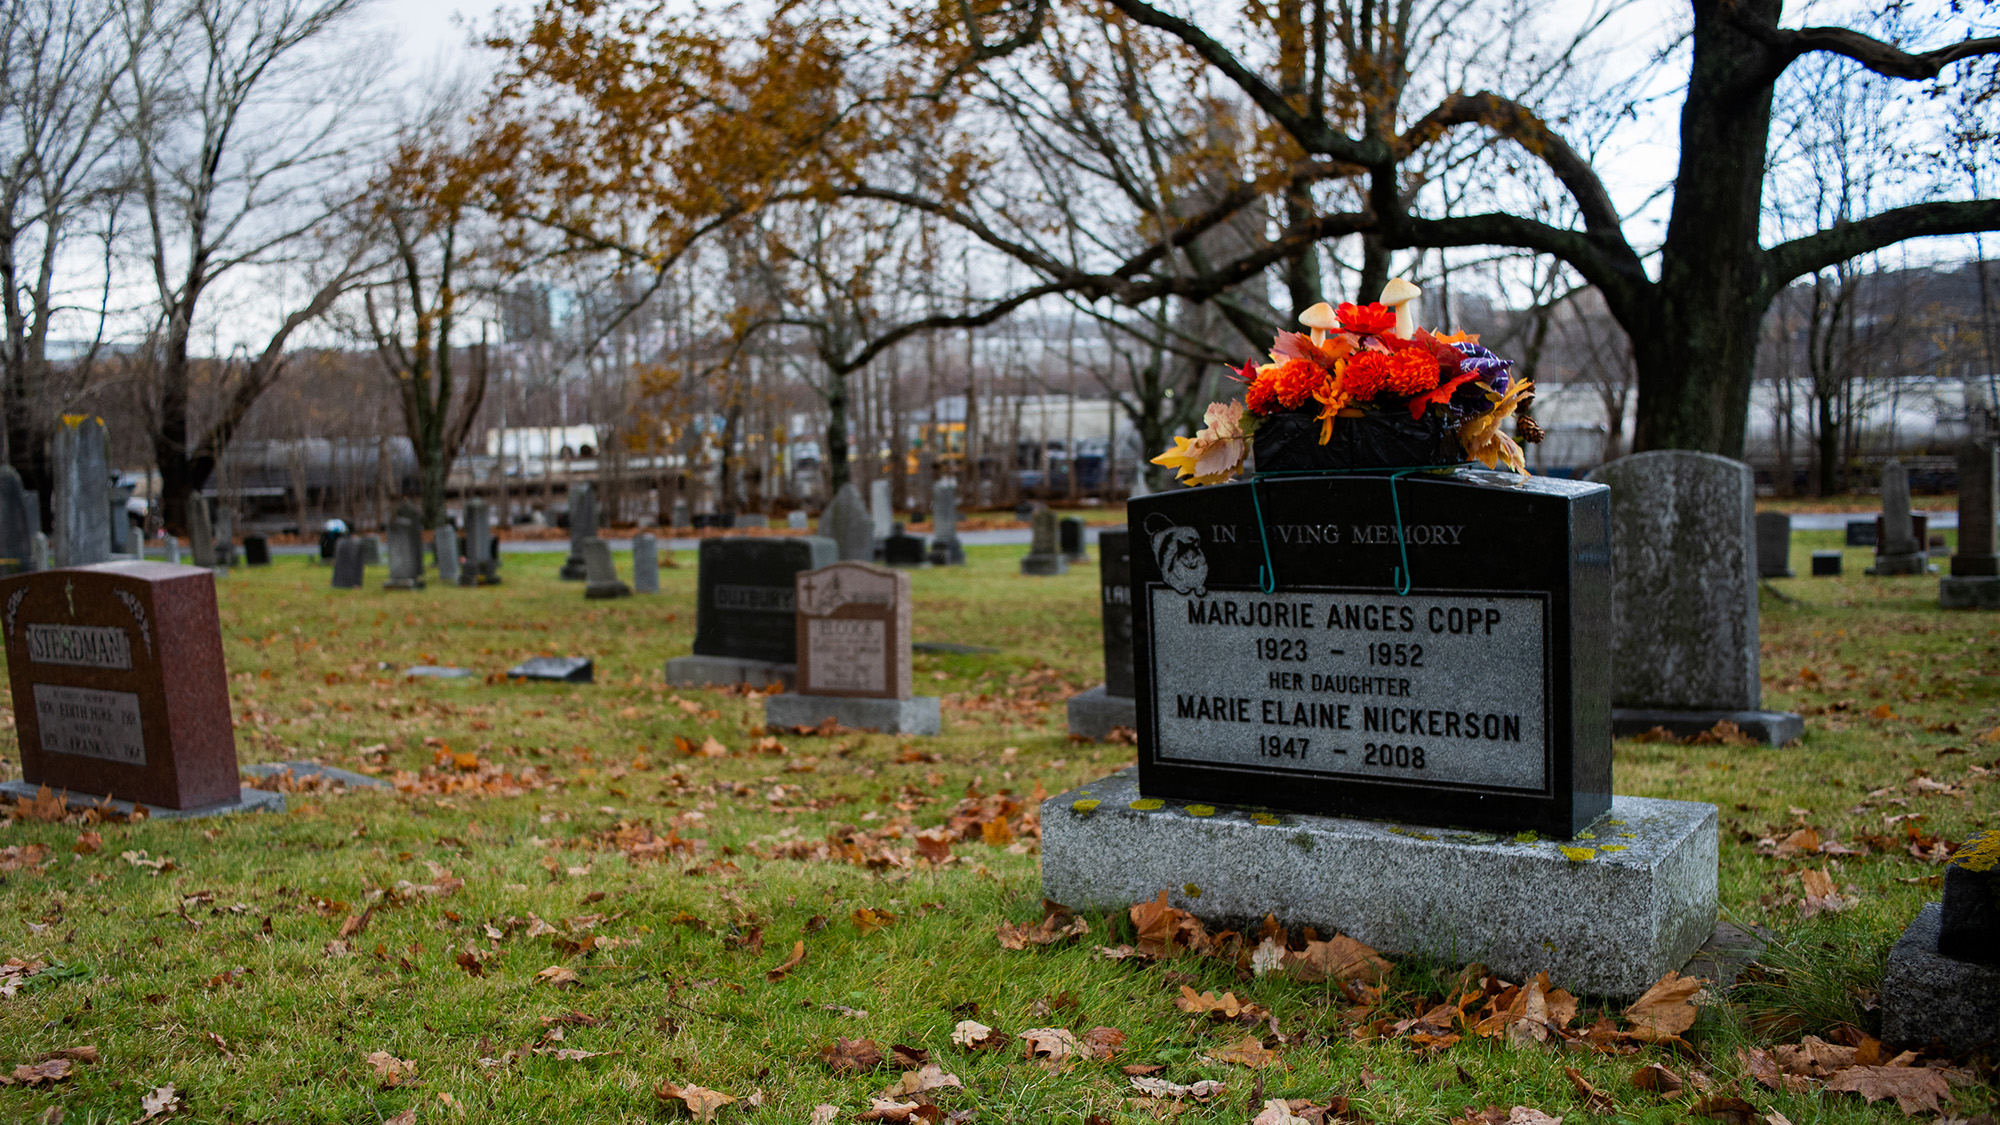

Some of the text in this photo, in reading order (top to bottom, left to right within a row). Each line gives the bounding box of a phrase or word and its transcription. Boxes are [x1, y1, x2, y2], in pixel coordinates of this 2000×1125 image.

[1212, 525, 1237, 544] IN
[1350, 524, 1465, 546] MEMORY
[1187, 600, 1501, 635] MARJORIE ANGES COPP
[1255, 637, 1308, 662] 1923
[1368, 642, 1424, 668] 1952
[1269, 671, 1411, 697] HER DAUGHTER
[1177, 694, 1521, 741] MARIE ELAINE NICKERSON
[1259, 735, 1310, 760] 1947
[1364, 742, 1426, 769] 2008
